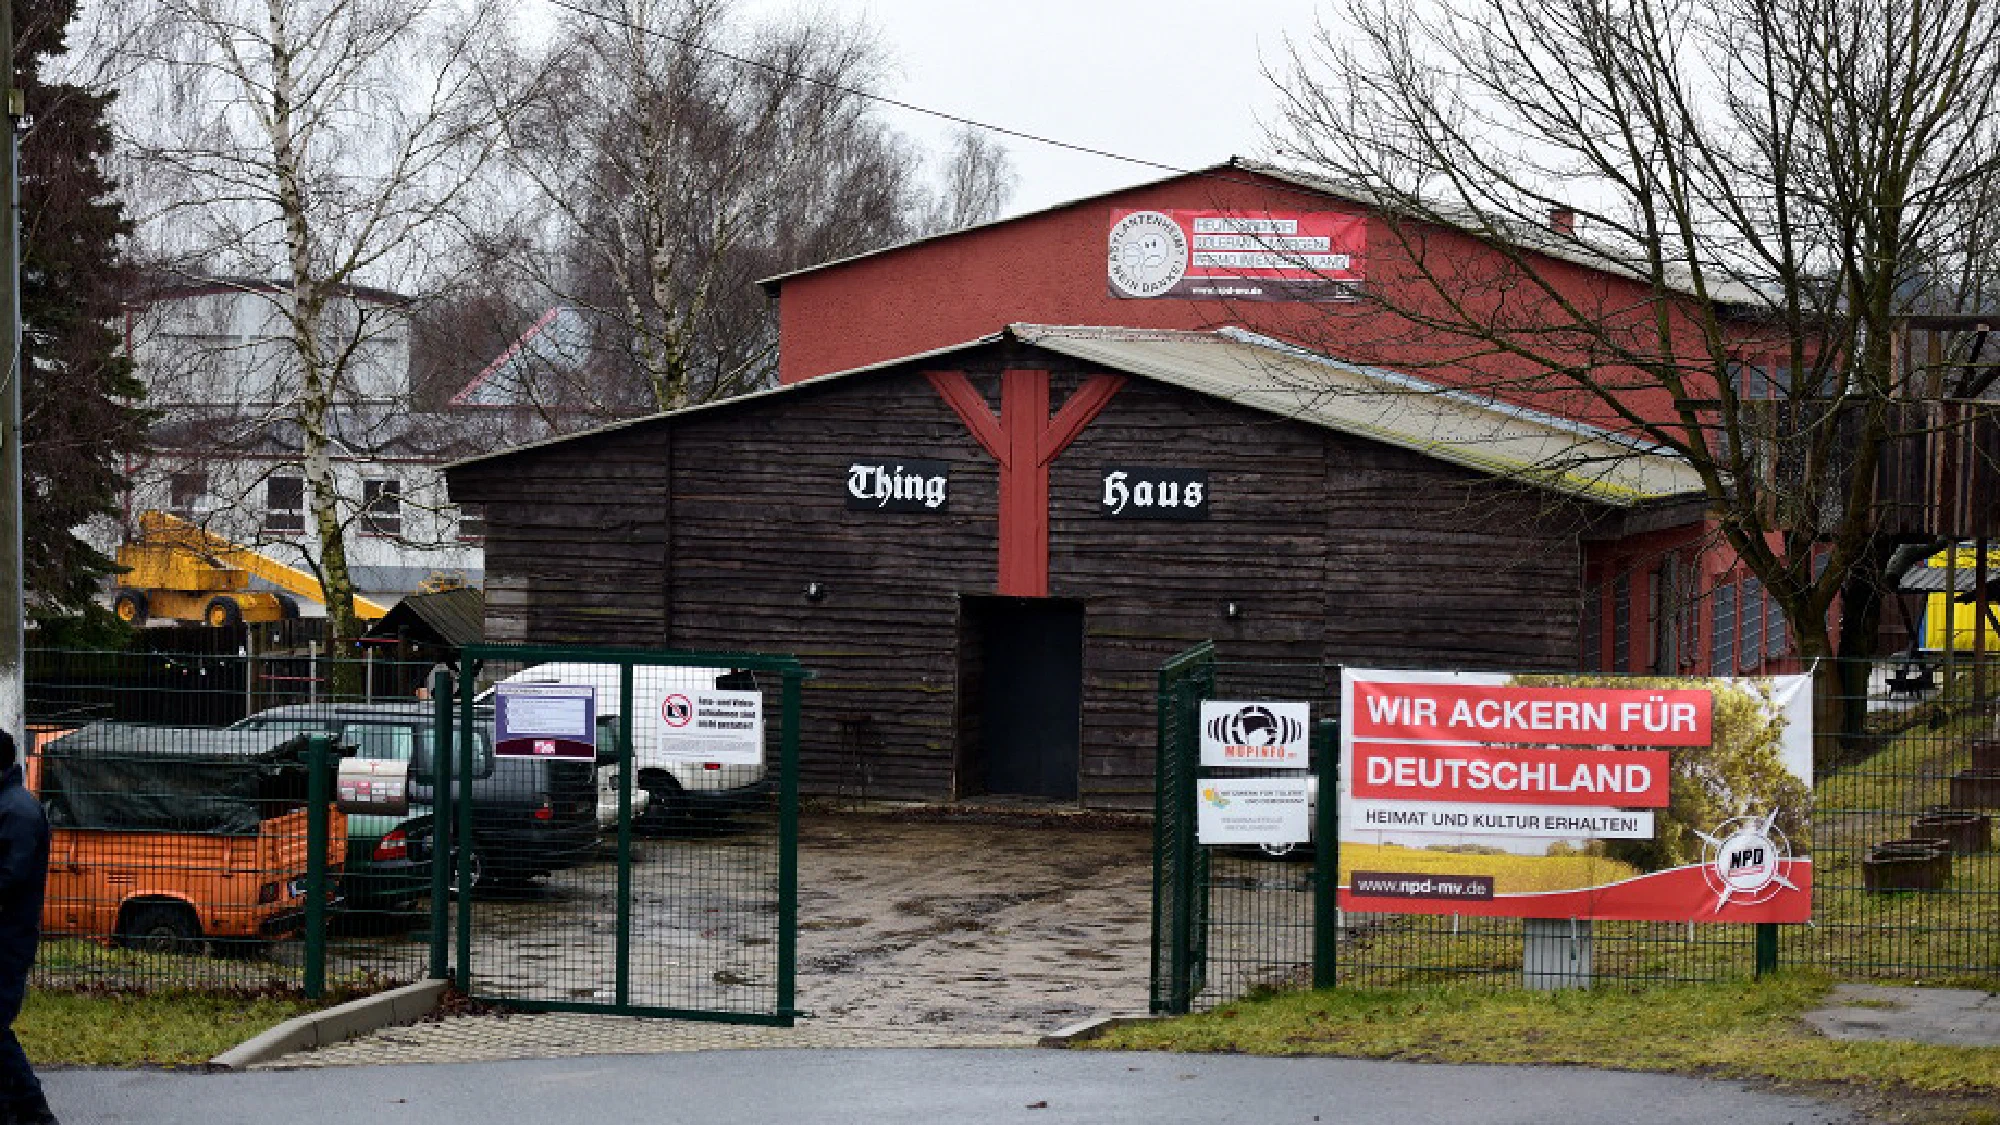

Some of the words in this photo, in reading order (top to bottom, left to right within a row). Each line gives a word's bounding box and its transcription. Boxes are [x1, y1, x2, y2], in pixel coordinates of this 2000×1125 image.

[847, 462, 947, 508] Thing
[1102, 470, 1204, 515] Haus
[1366, 695, 1437, 727] WIR
[1448, 699, 1606, 732] ACKERN
[1621, 695, 1697, 732] FÜR
[1366, 756, 1652, 794] DEUTSCHLAND
[1366, 809, 1428, 824] HEIMAT
[1431, 811, 1469, 827] UND
[1472, 812, 1540, 829] KULTUR
[1544, 815, 1638, 832] ERHALTEN!
[1731, 848, 1764, 869] NPD
[1357, 878, 1487, 897] www.npd-mv.de
